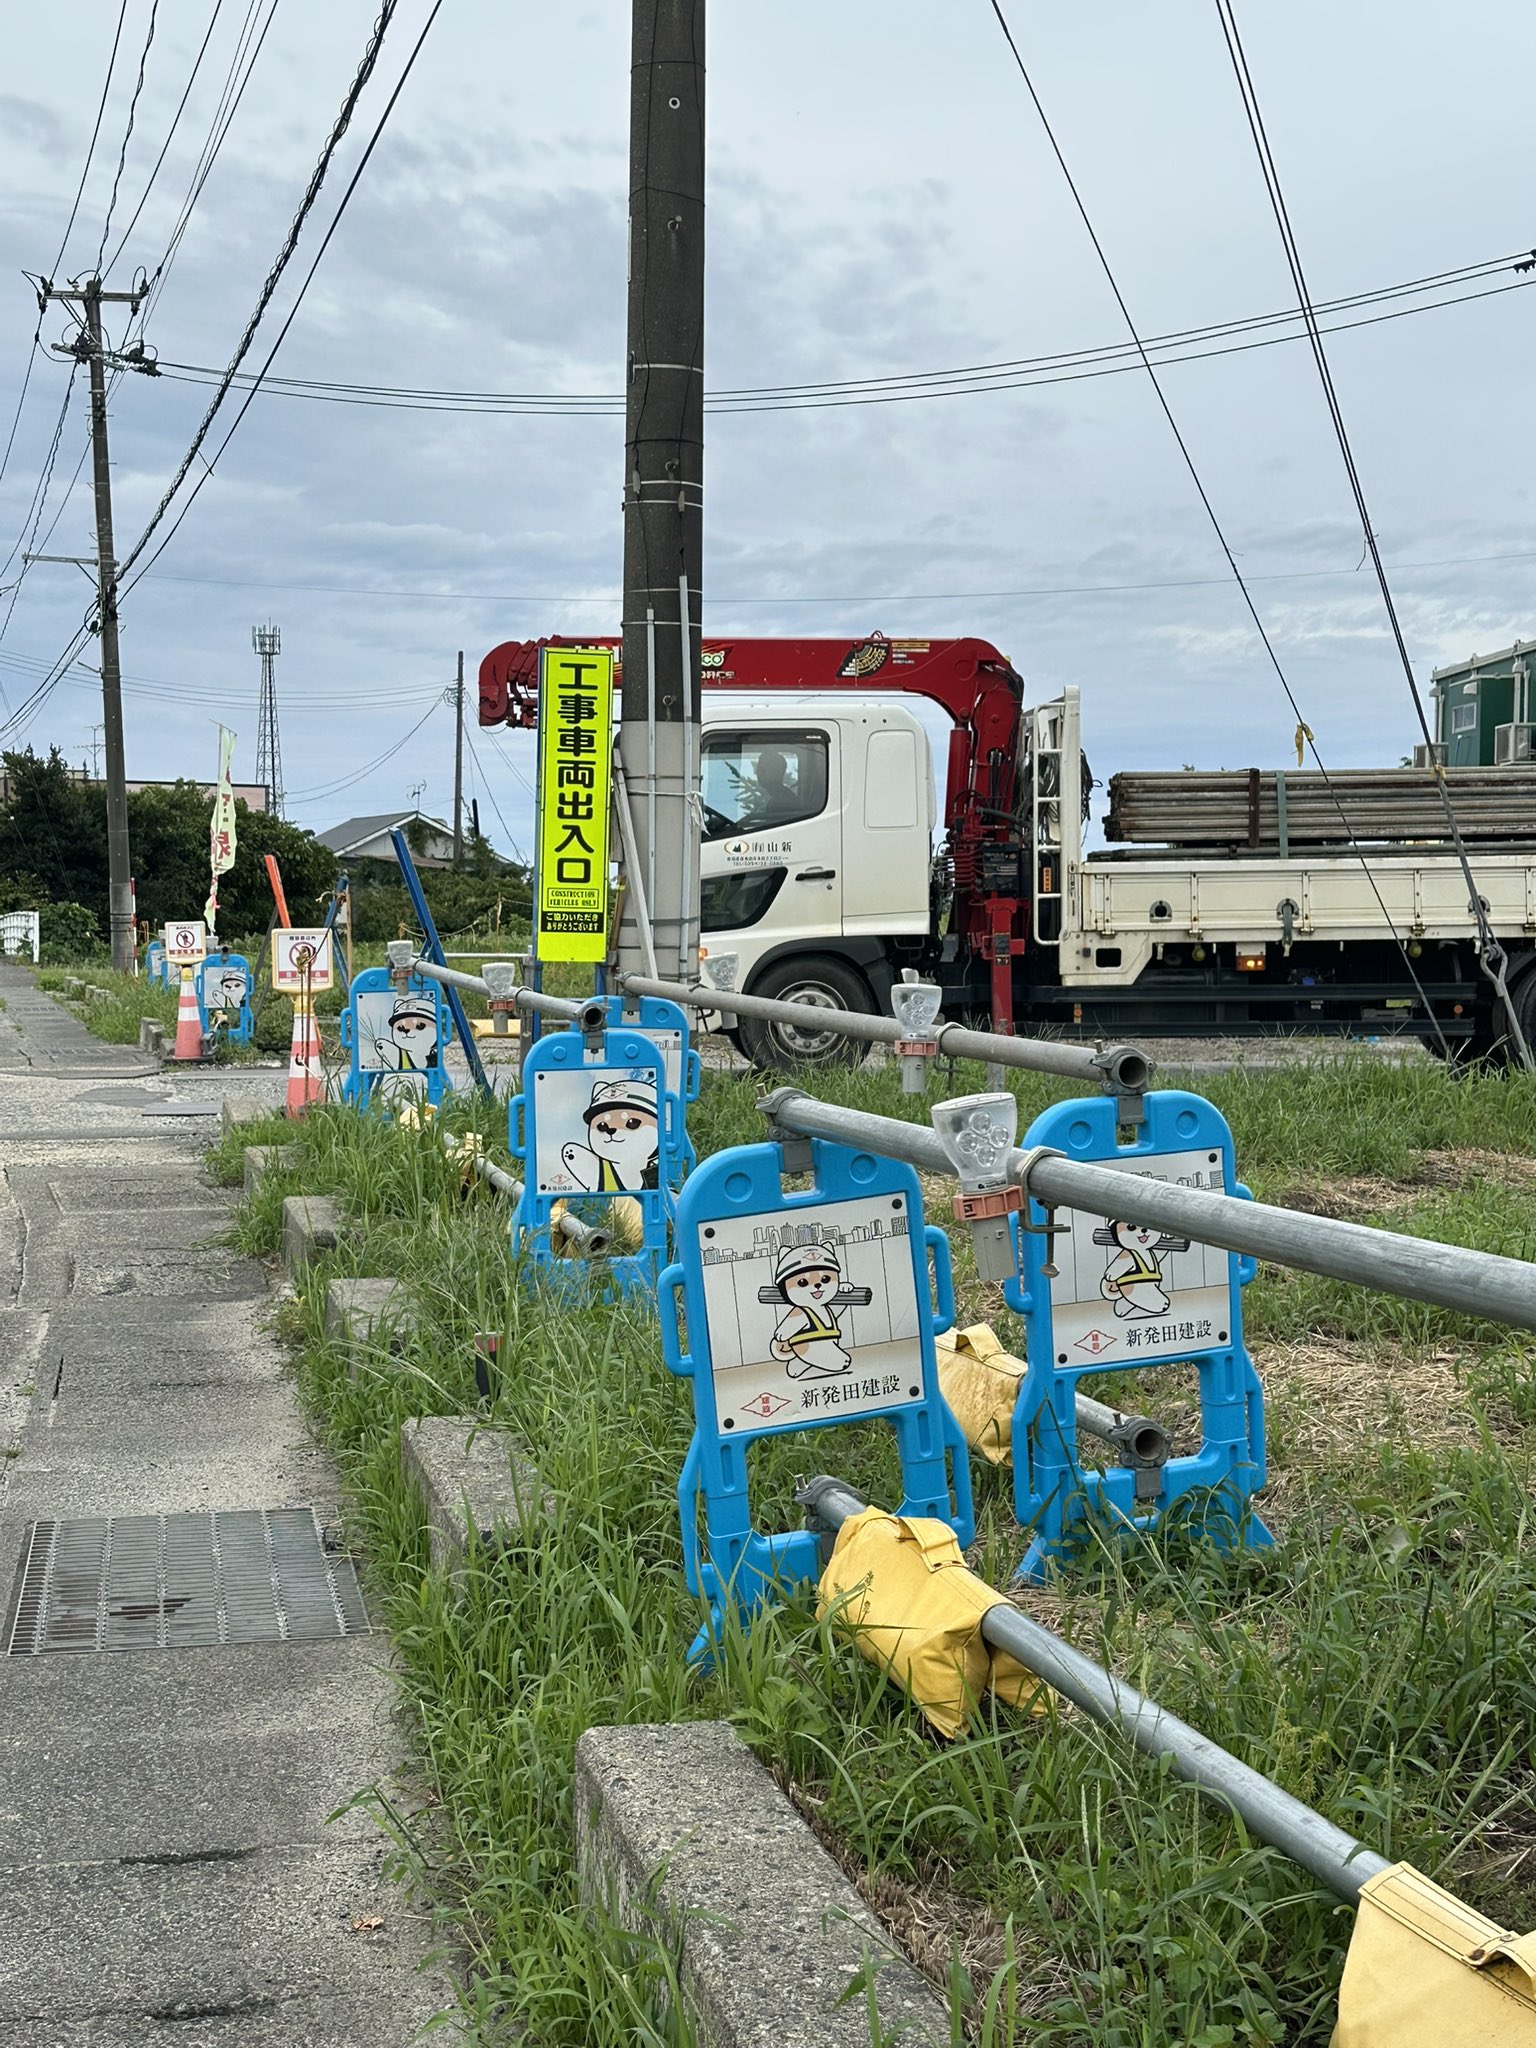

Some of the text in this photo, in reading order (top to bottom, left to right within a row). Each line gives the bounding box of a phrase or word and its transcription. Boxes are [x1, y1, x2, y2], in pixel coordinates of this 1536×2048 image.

[554, 662, 598, 884] 工事車両出入口
[546, 912, 599, 922] ご協力いただき
[546, 922, 599, 931] ありがとうございます
[1126, 1320, 1212, 1348] 新発田建設
[801, 1375, 900, 1409] 新発田建設
